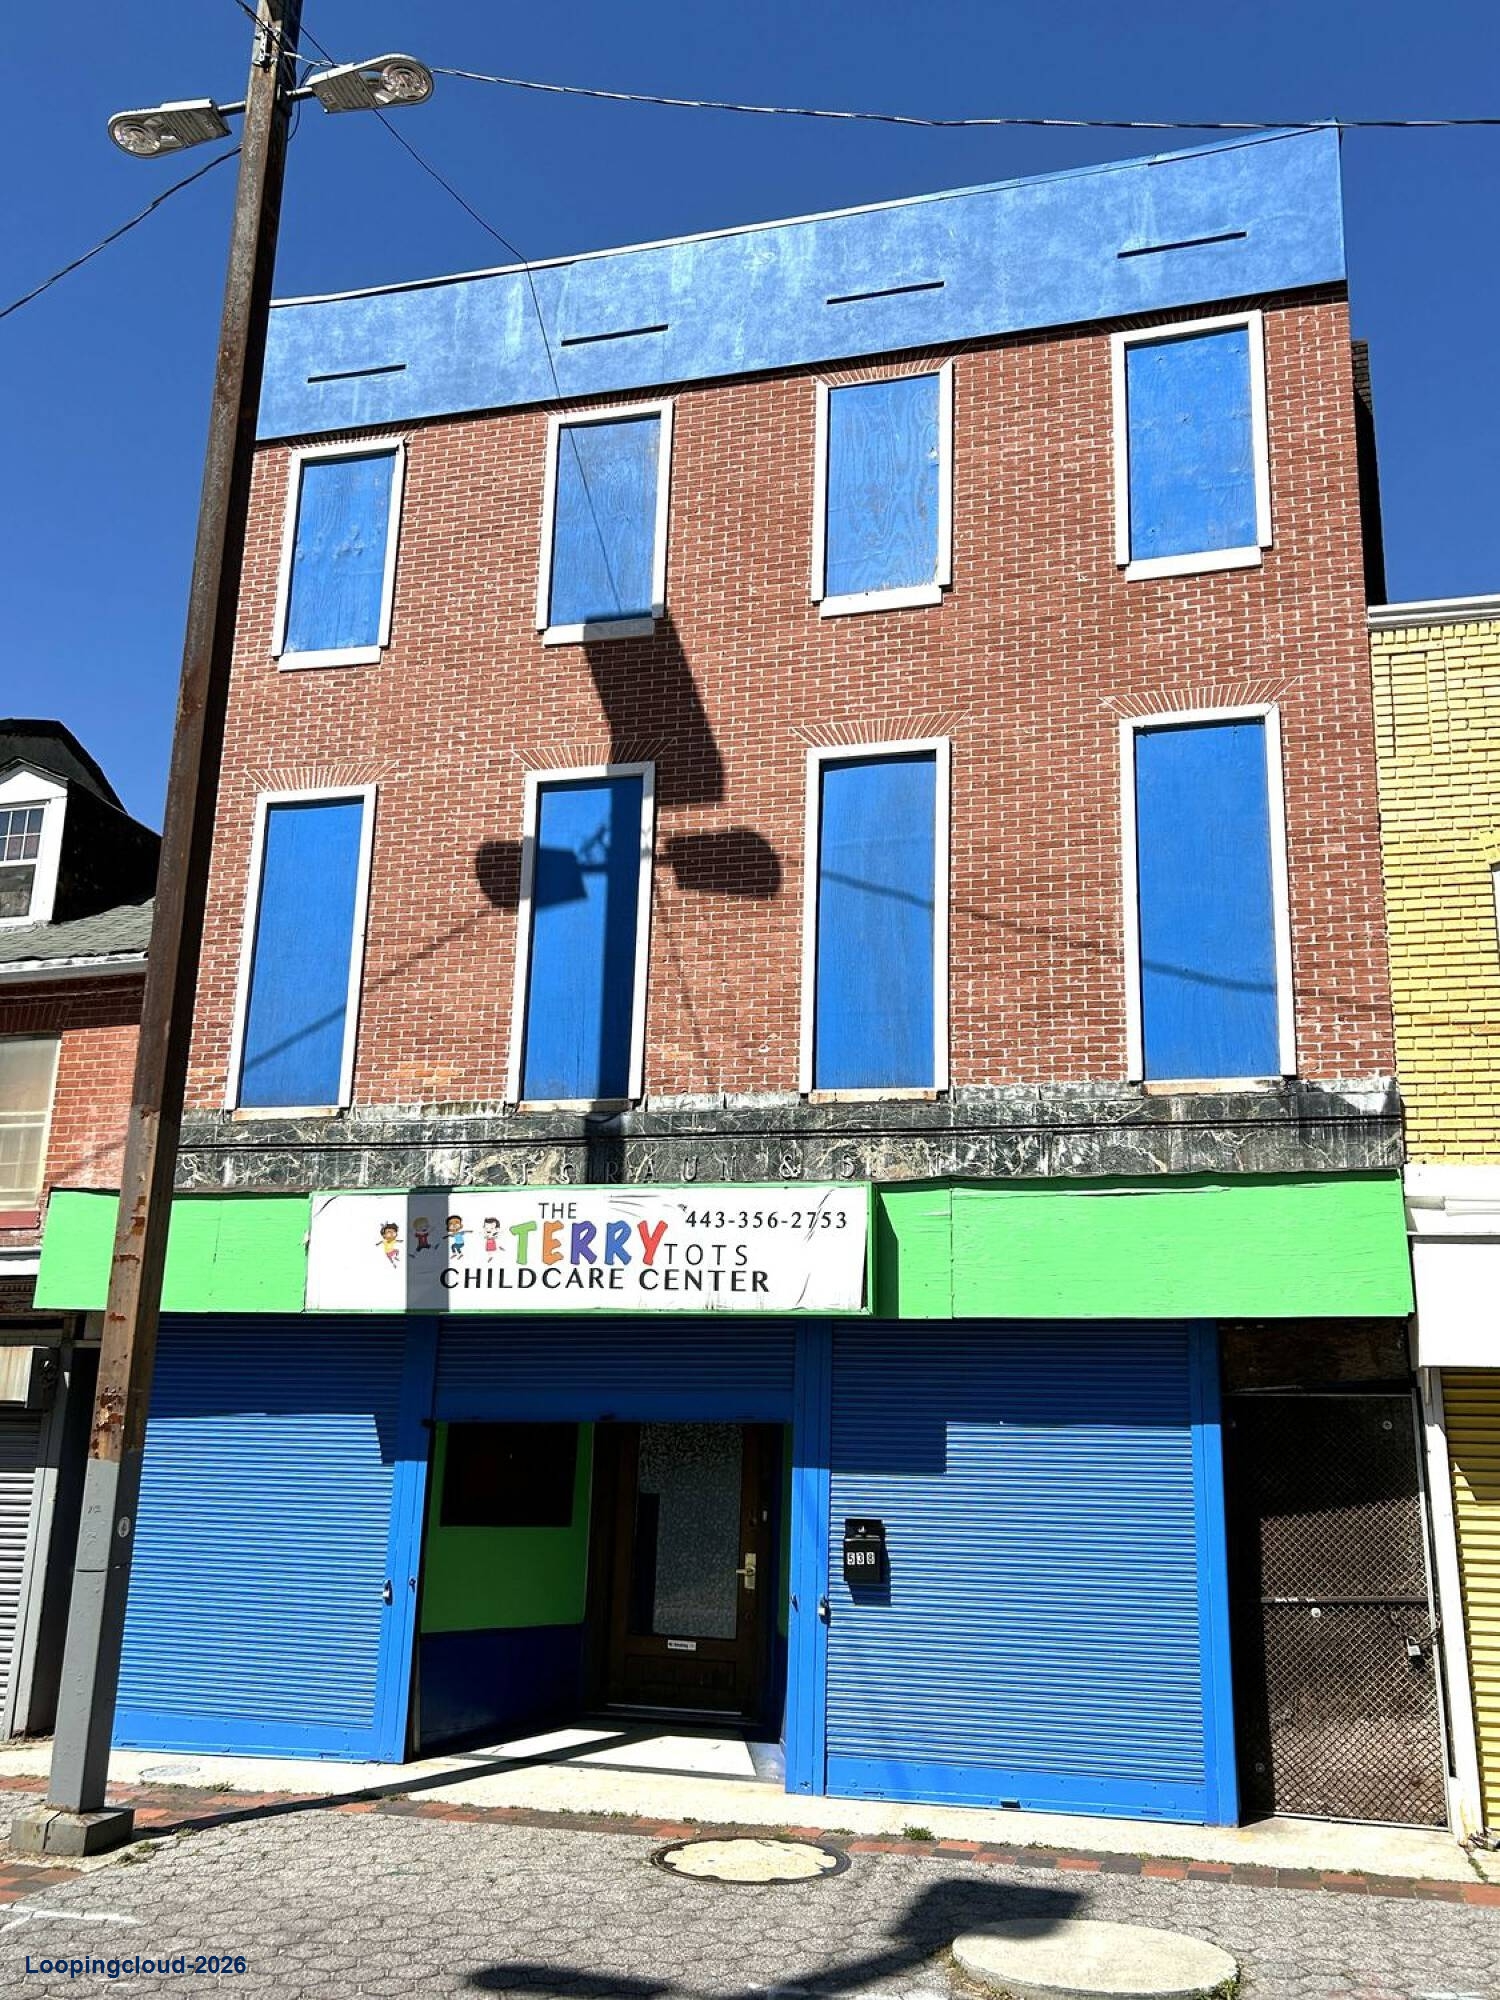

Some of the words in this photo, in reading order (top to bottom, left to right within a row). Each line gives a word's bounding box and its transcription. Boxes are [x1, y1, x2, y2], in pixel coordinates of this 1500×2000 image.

[538, 1202, 577, 1219] THE
[685, 1211, 847, 1229] 443-356-2753
[509, 1219, 668, 1266] TERRY
[664, 1243, 748, 1266] TOTS
[439, 1267, 624, 1290] CHILDCARE
[639, 1268, 770, 1293] CENTER
